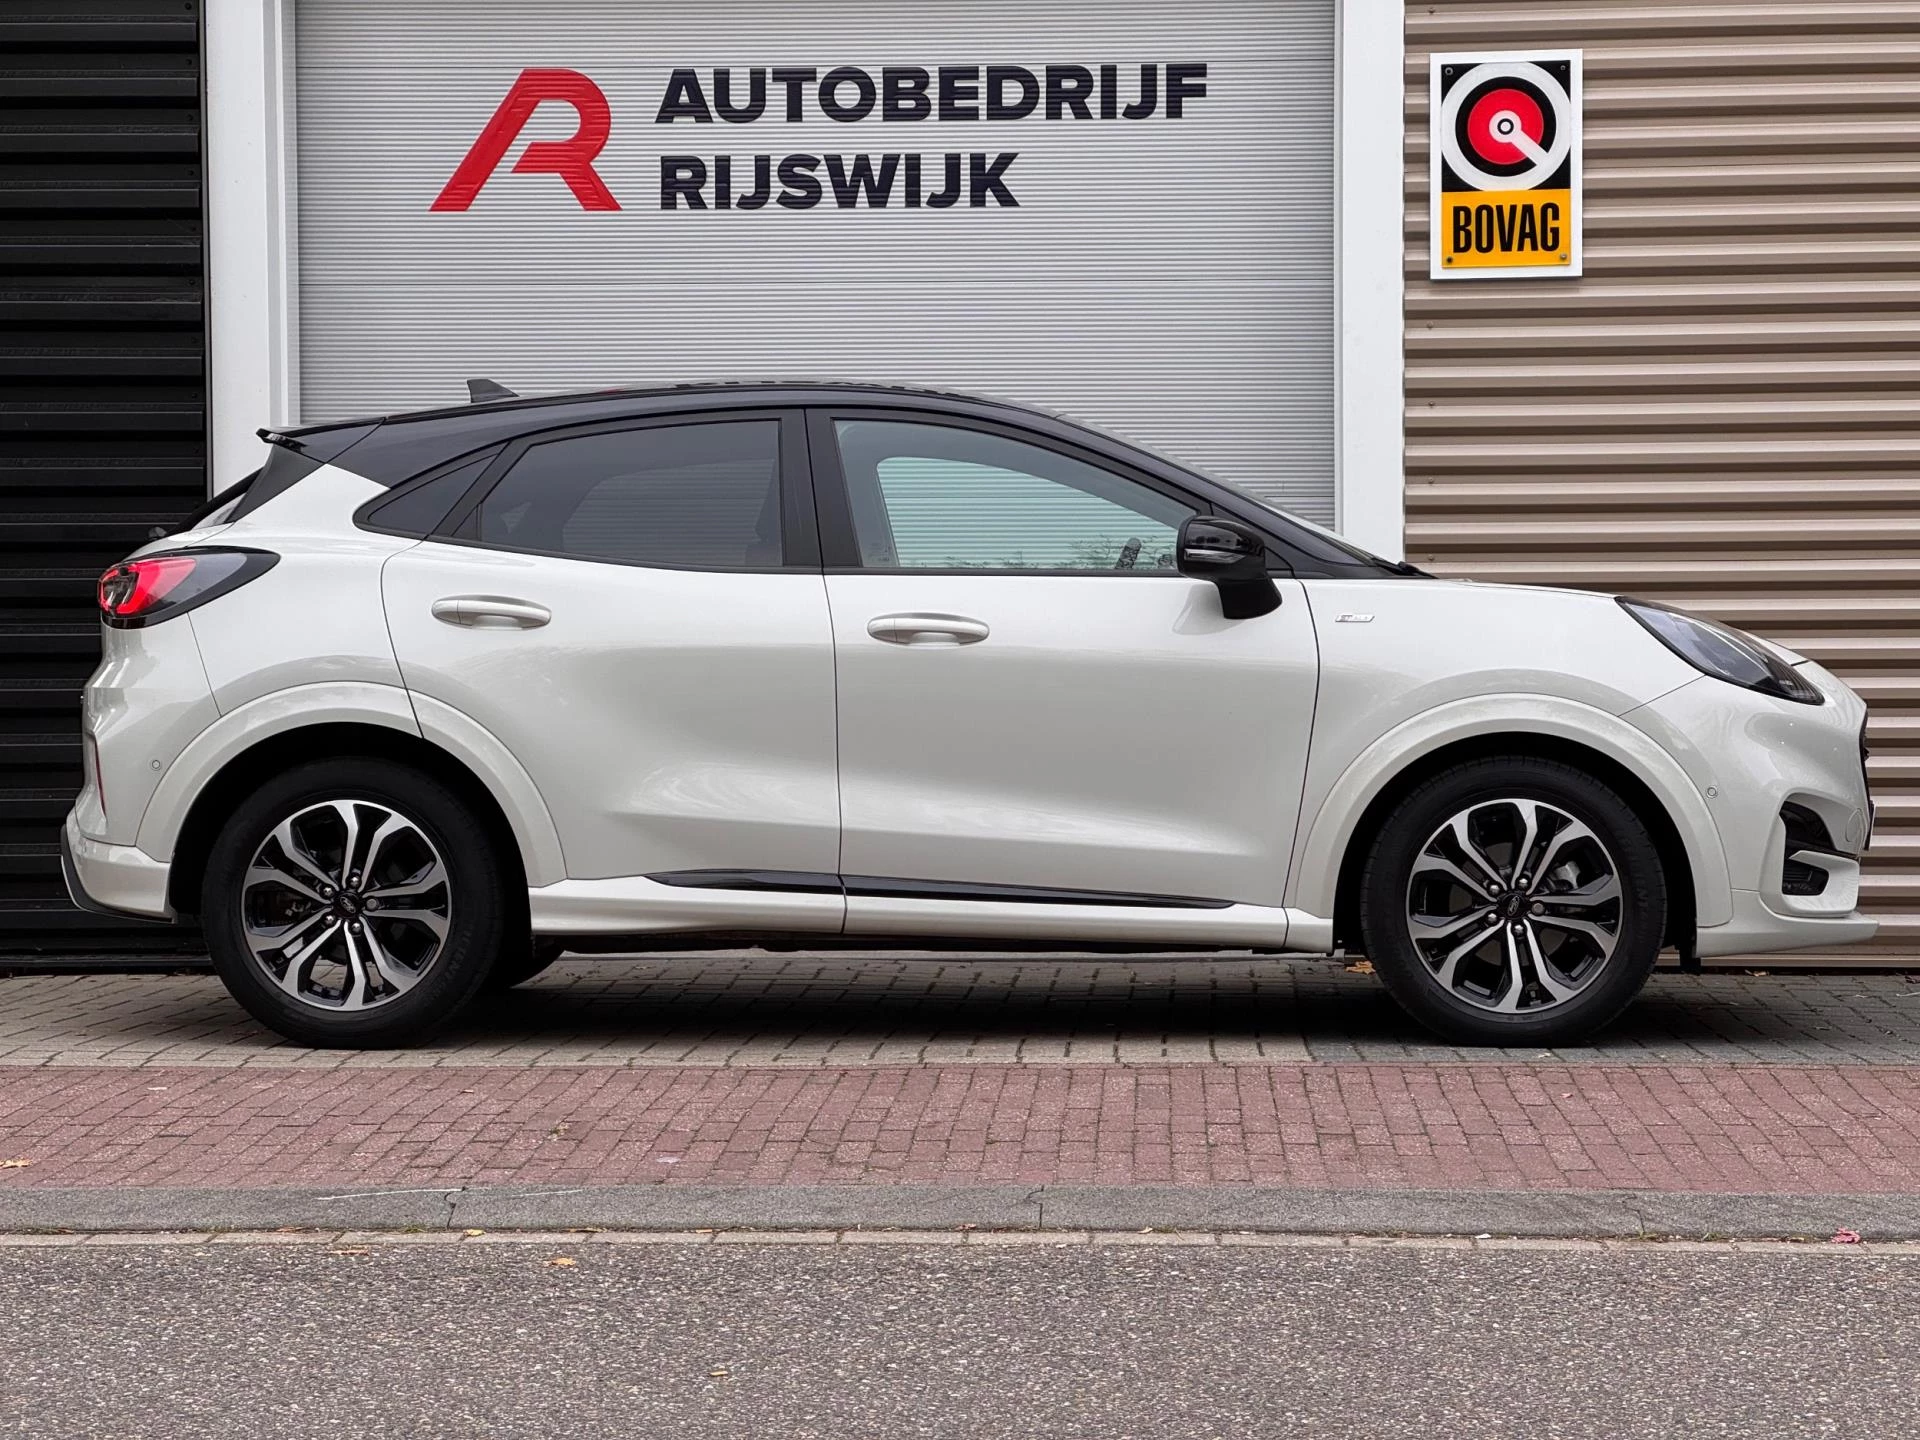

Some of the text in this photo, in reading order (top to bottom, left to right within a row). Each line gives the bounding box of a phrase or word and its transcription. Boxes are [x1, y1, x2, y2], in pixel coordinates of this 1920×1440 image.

[655, 62, 1208, 124] AUTOBEDRIJF
[660, 152, 1021, 211] RIJSWIJK
[1452, 202, 1561, 254] BOVAG
